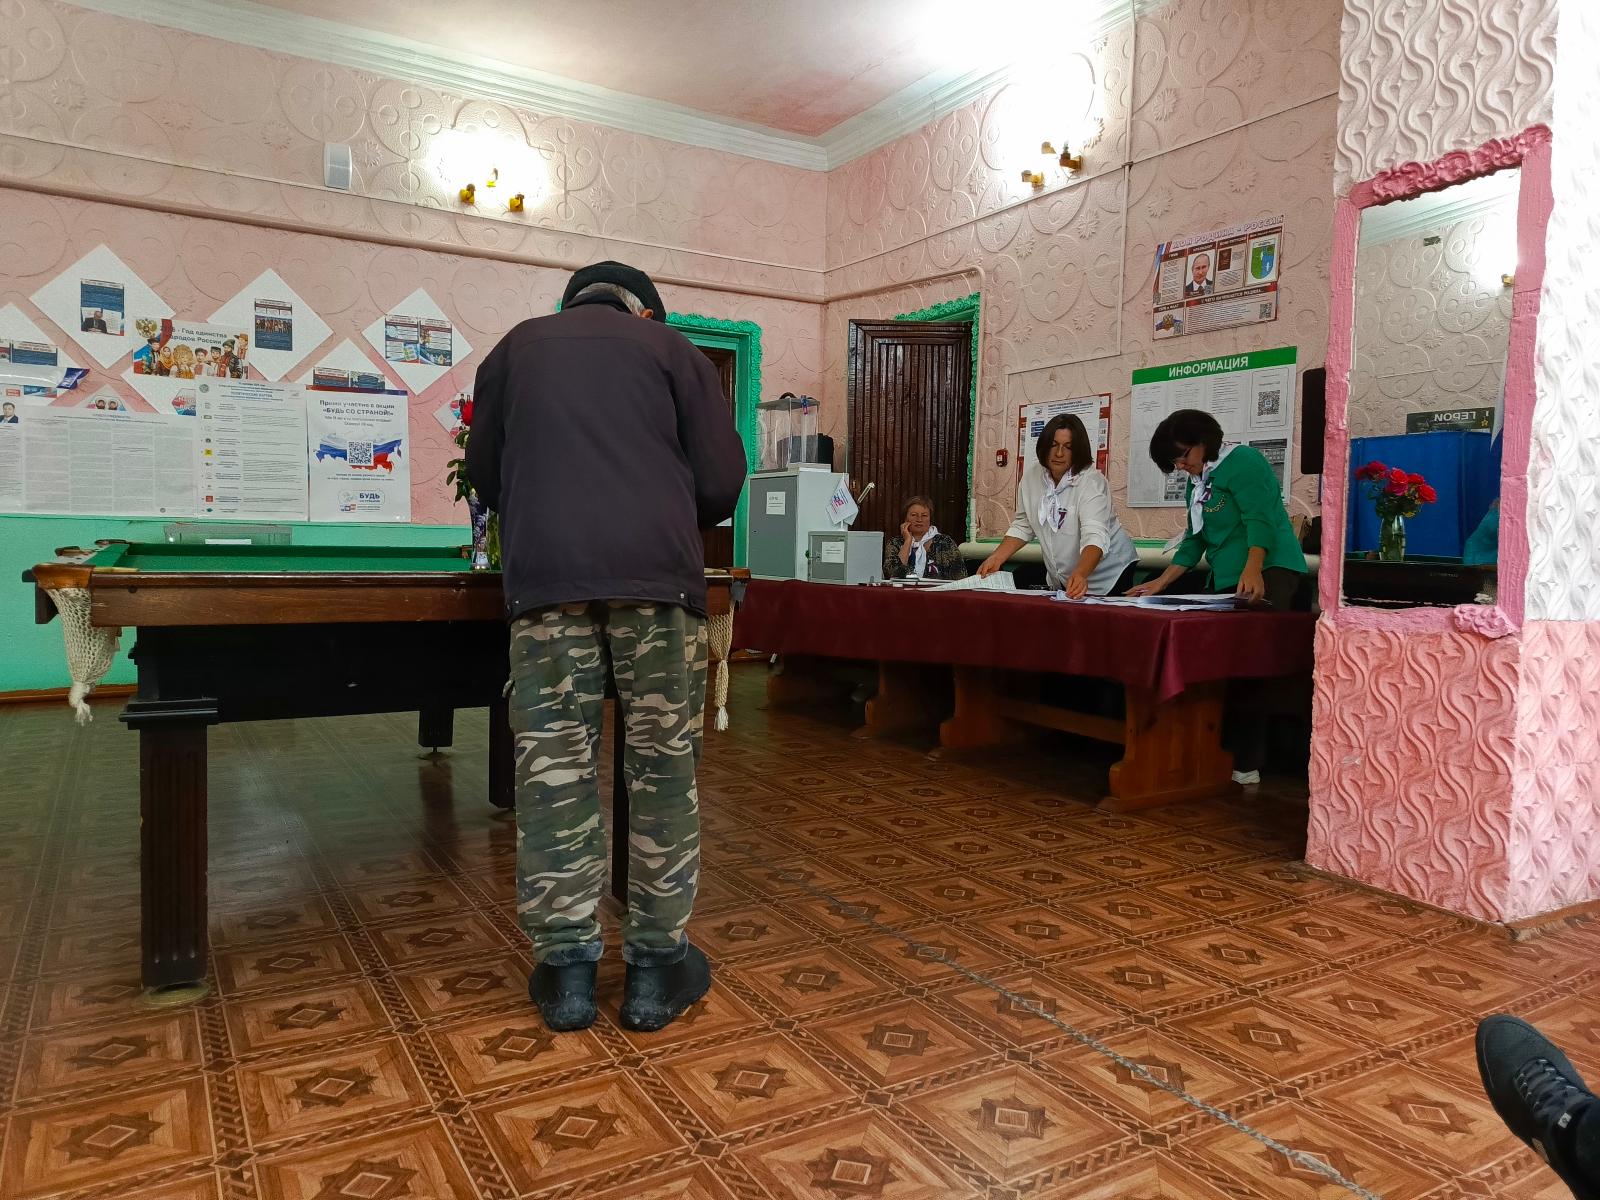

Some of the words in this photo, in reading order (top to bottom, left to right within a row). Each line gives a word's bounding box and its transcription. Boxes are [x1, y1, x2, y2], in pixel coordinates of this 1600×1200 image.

[1195, 228, 1234, 244] РОДИНА
[1244, 217, 1284, 231] РОССИЯ
[1168, 356, 1249, 378] ИНФОРМАЦИЯ
